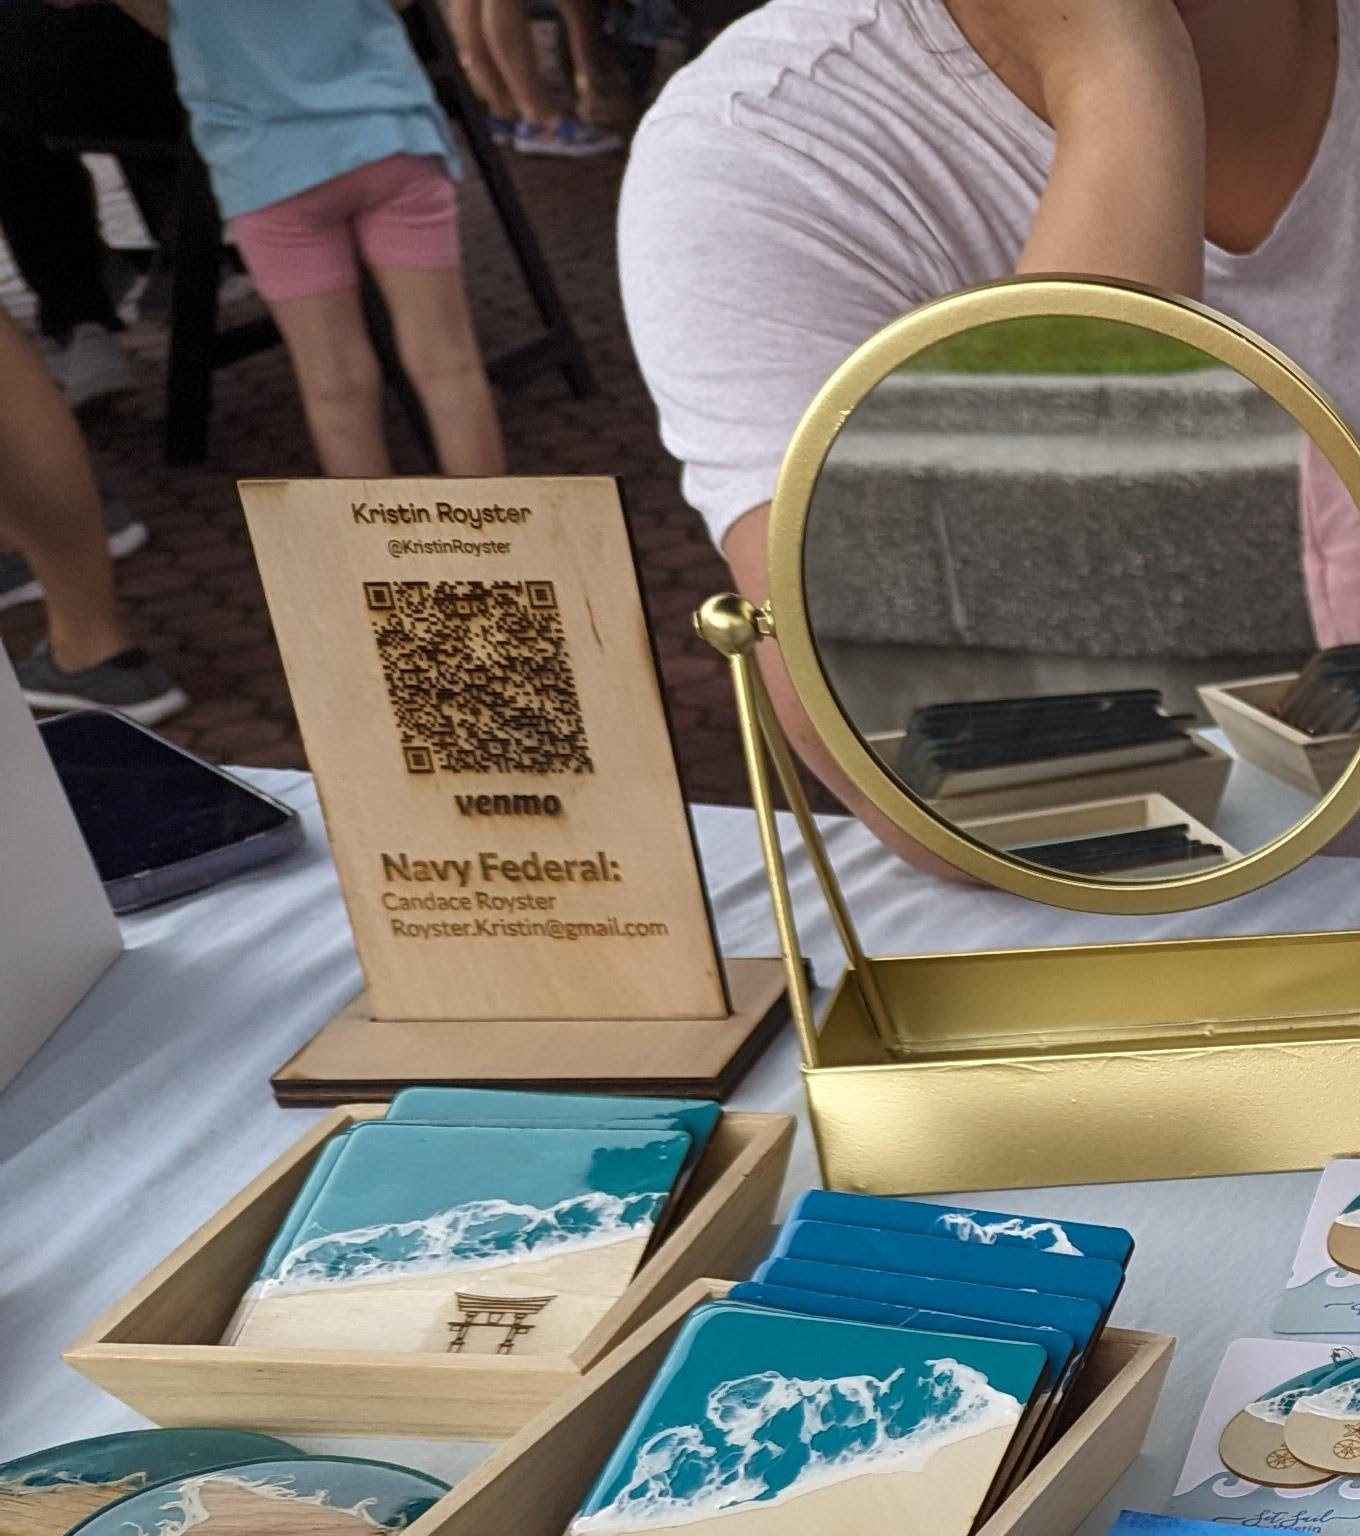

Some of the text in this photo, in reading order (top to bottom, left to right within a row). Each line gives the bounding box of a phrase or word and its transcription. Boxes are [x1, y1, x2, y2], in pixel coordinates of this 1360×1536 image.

[352, 502, 532, 529] Kristin Royster
[387, 538, 511, 557] @KristinRoyster
[455, 793, 563, 818] venmo
[381, 852, 622, 887] Navy Federal:
[381, 892, 556, 914] Candace Royster
[392, 917, 669, 941] Royster.Kristin@gmail.com
